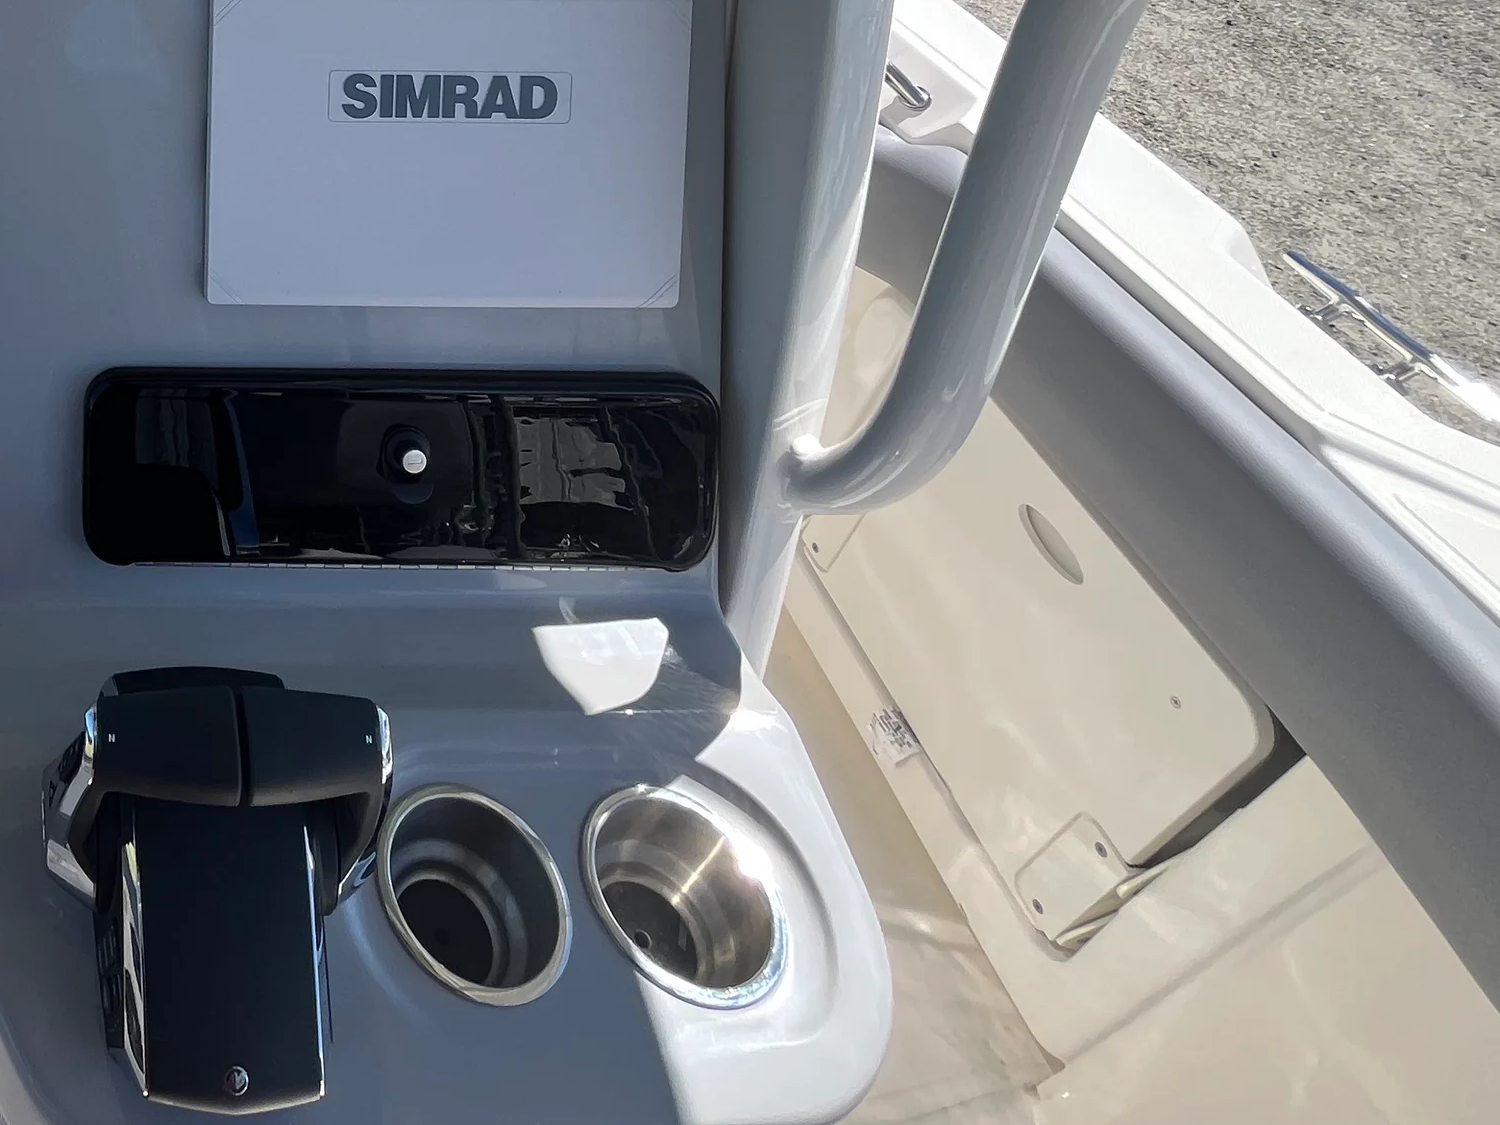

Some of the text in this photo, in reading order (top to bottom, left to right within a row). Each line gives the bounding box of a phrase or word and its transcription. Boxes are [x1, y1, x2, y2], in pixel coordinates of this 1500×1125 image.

[341, 73, 558, 120] SIMRAD
[108, 733, 116, 743] N
[365, 734, 373, 745] N
